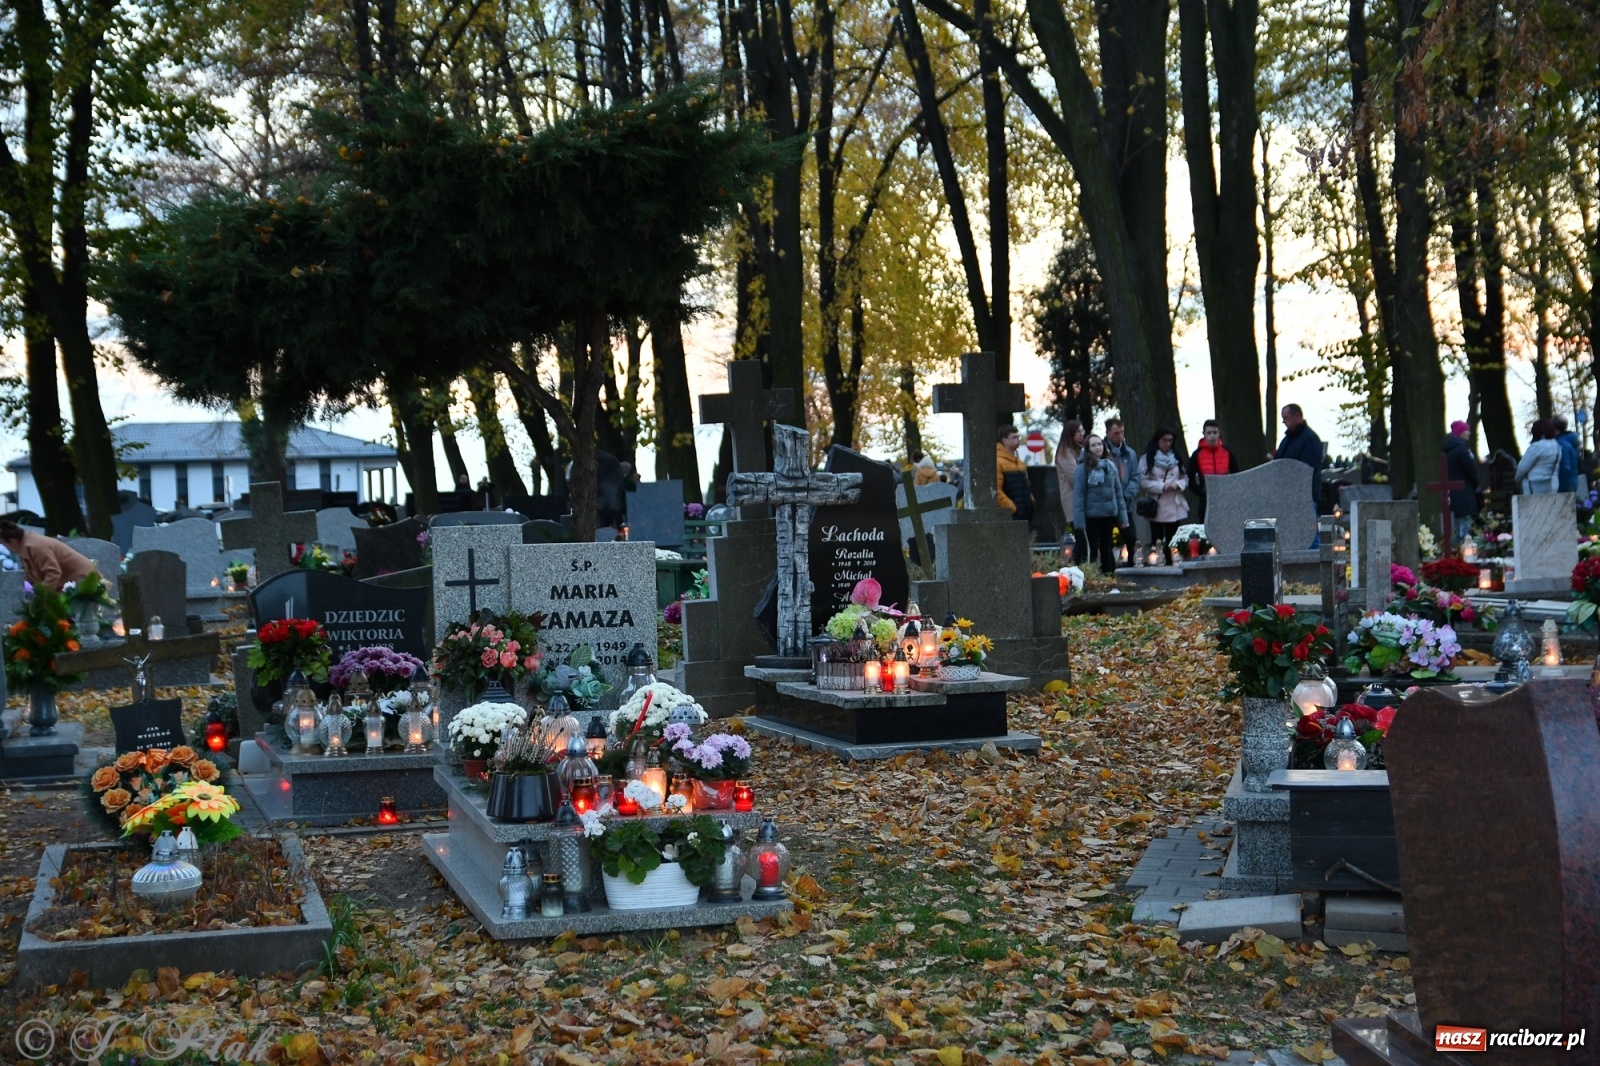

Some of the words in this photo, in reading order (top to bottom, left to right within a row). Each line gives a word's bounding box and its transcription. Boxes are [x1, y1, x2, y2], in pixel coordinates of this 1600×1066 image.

[835, 548, 874, 559] Rozalia
[550, 584, 618, 600] MARIA
[324, 609, 406, 624] DZIEDZIC
[327, 628, 404, 641] WIKTORIA
